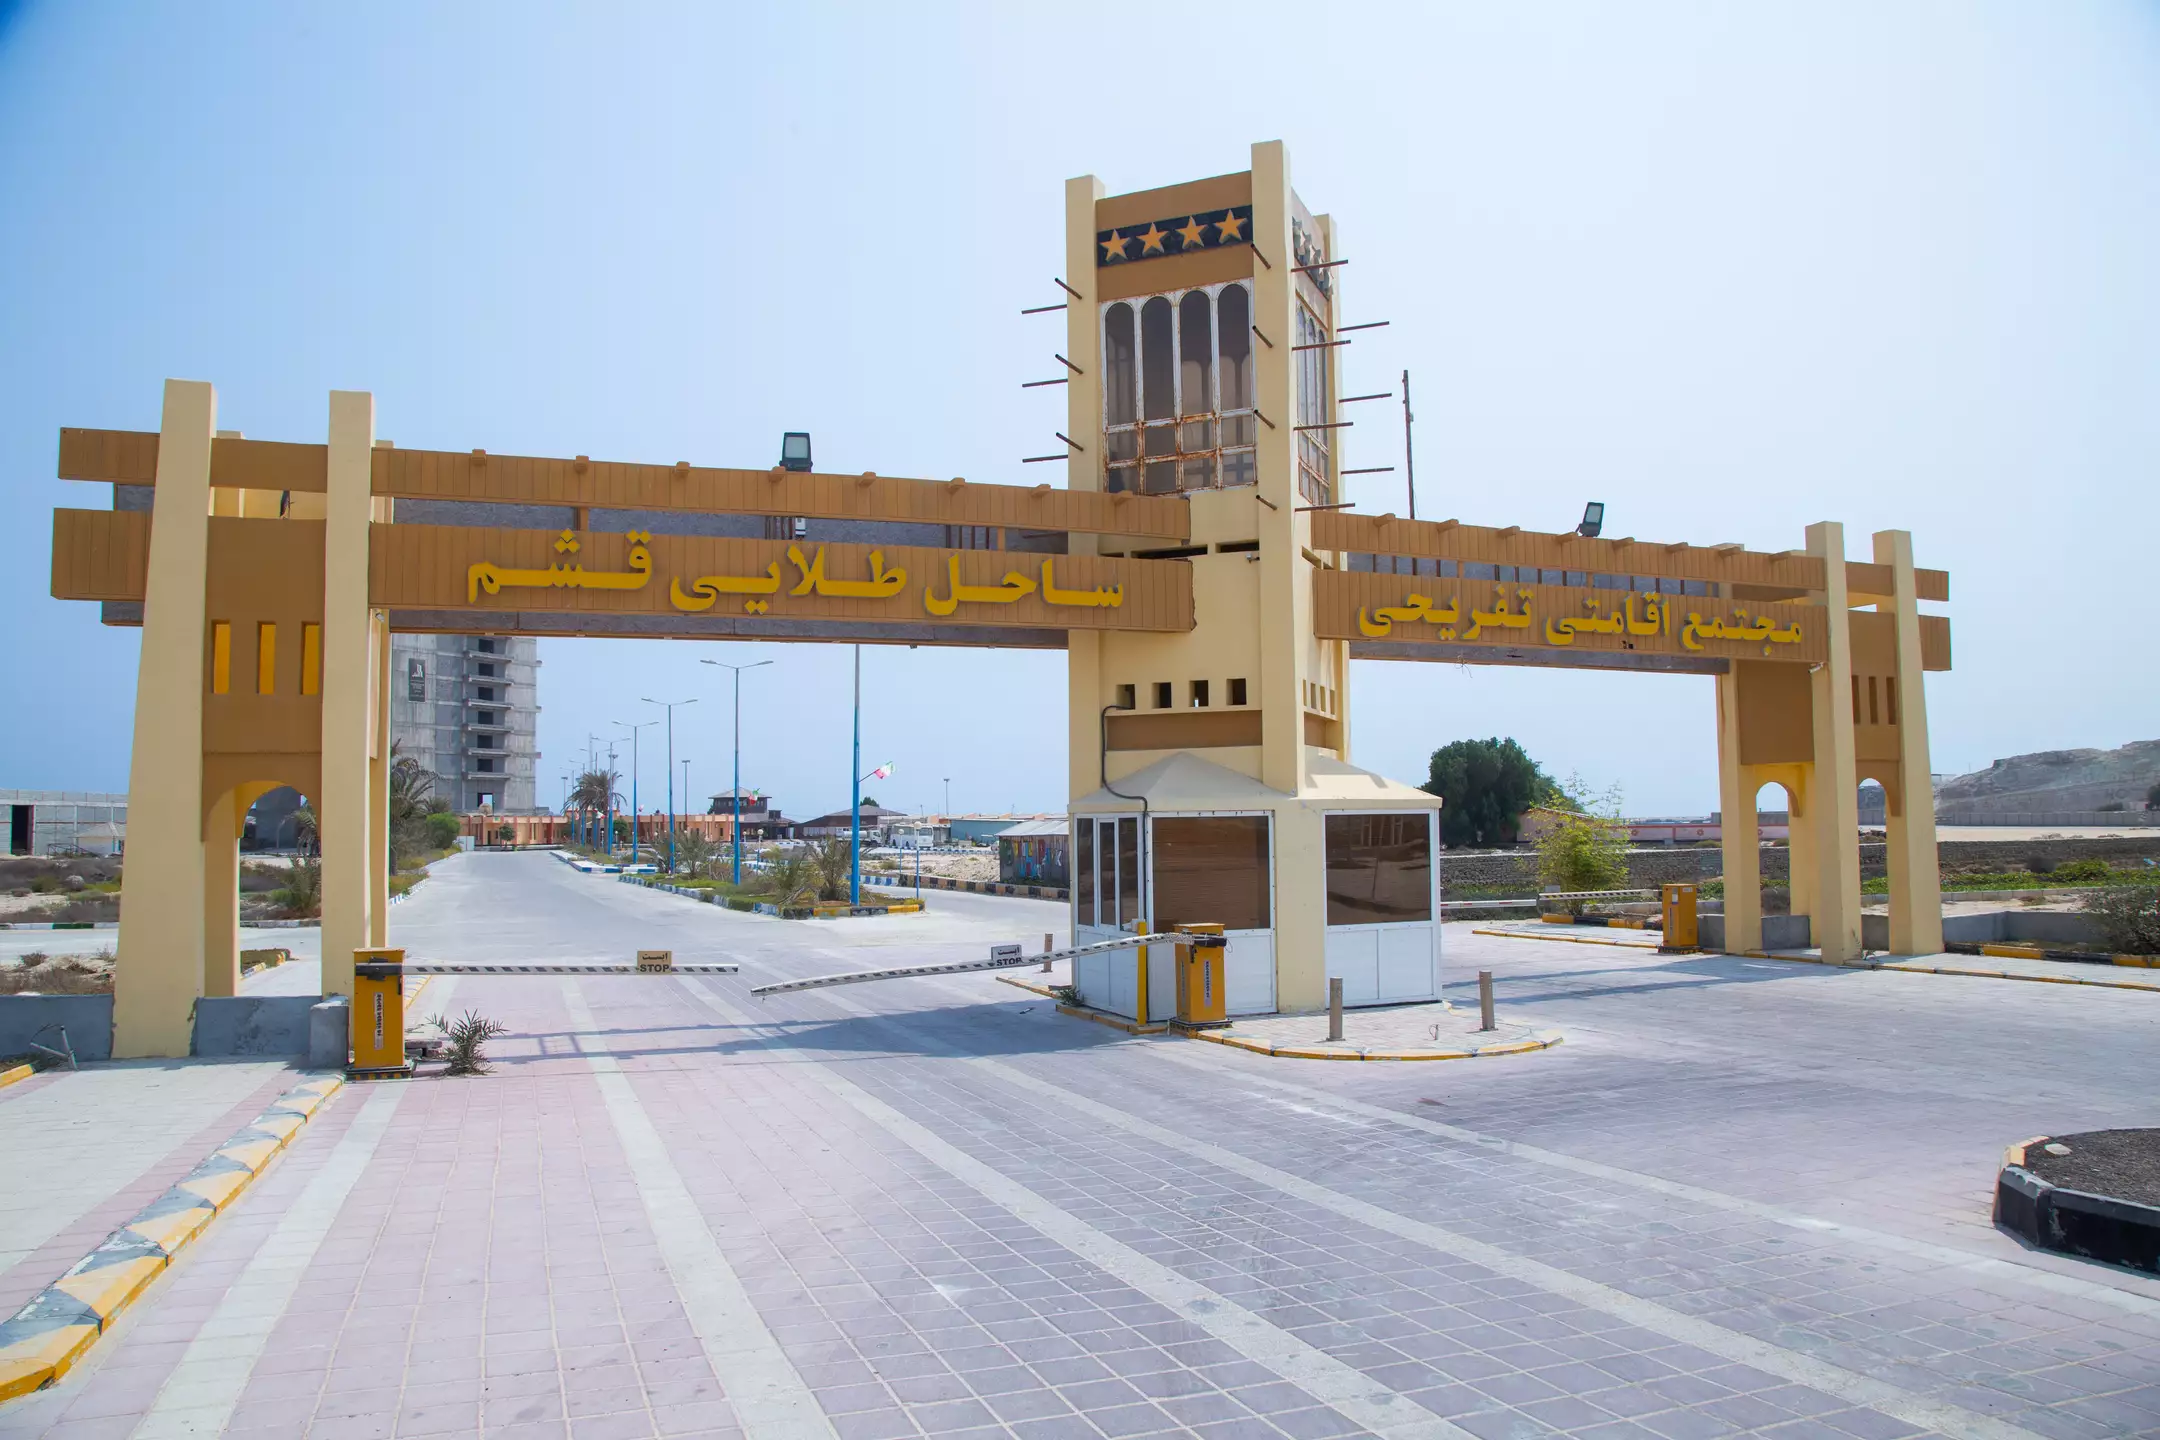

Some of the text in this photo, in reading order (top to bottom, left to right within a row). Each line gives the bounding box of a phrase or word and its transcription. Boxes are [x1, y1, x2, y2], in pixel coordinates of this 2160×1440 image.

[467, 529, 1124, 616] ساحل طلایی قشم
[1358, 585, 1803, 655] مجتمع اقامتی تفریحی
[642, 952, 668, 962] ایست
[997, 957, 1023, 966] STOP
[640, 964, 669, 972] STOP
